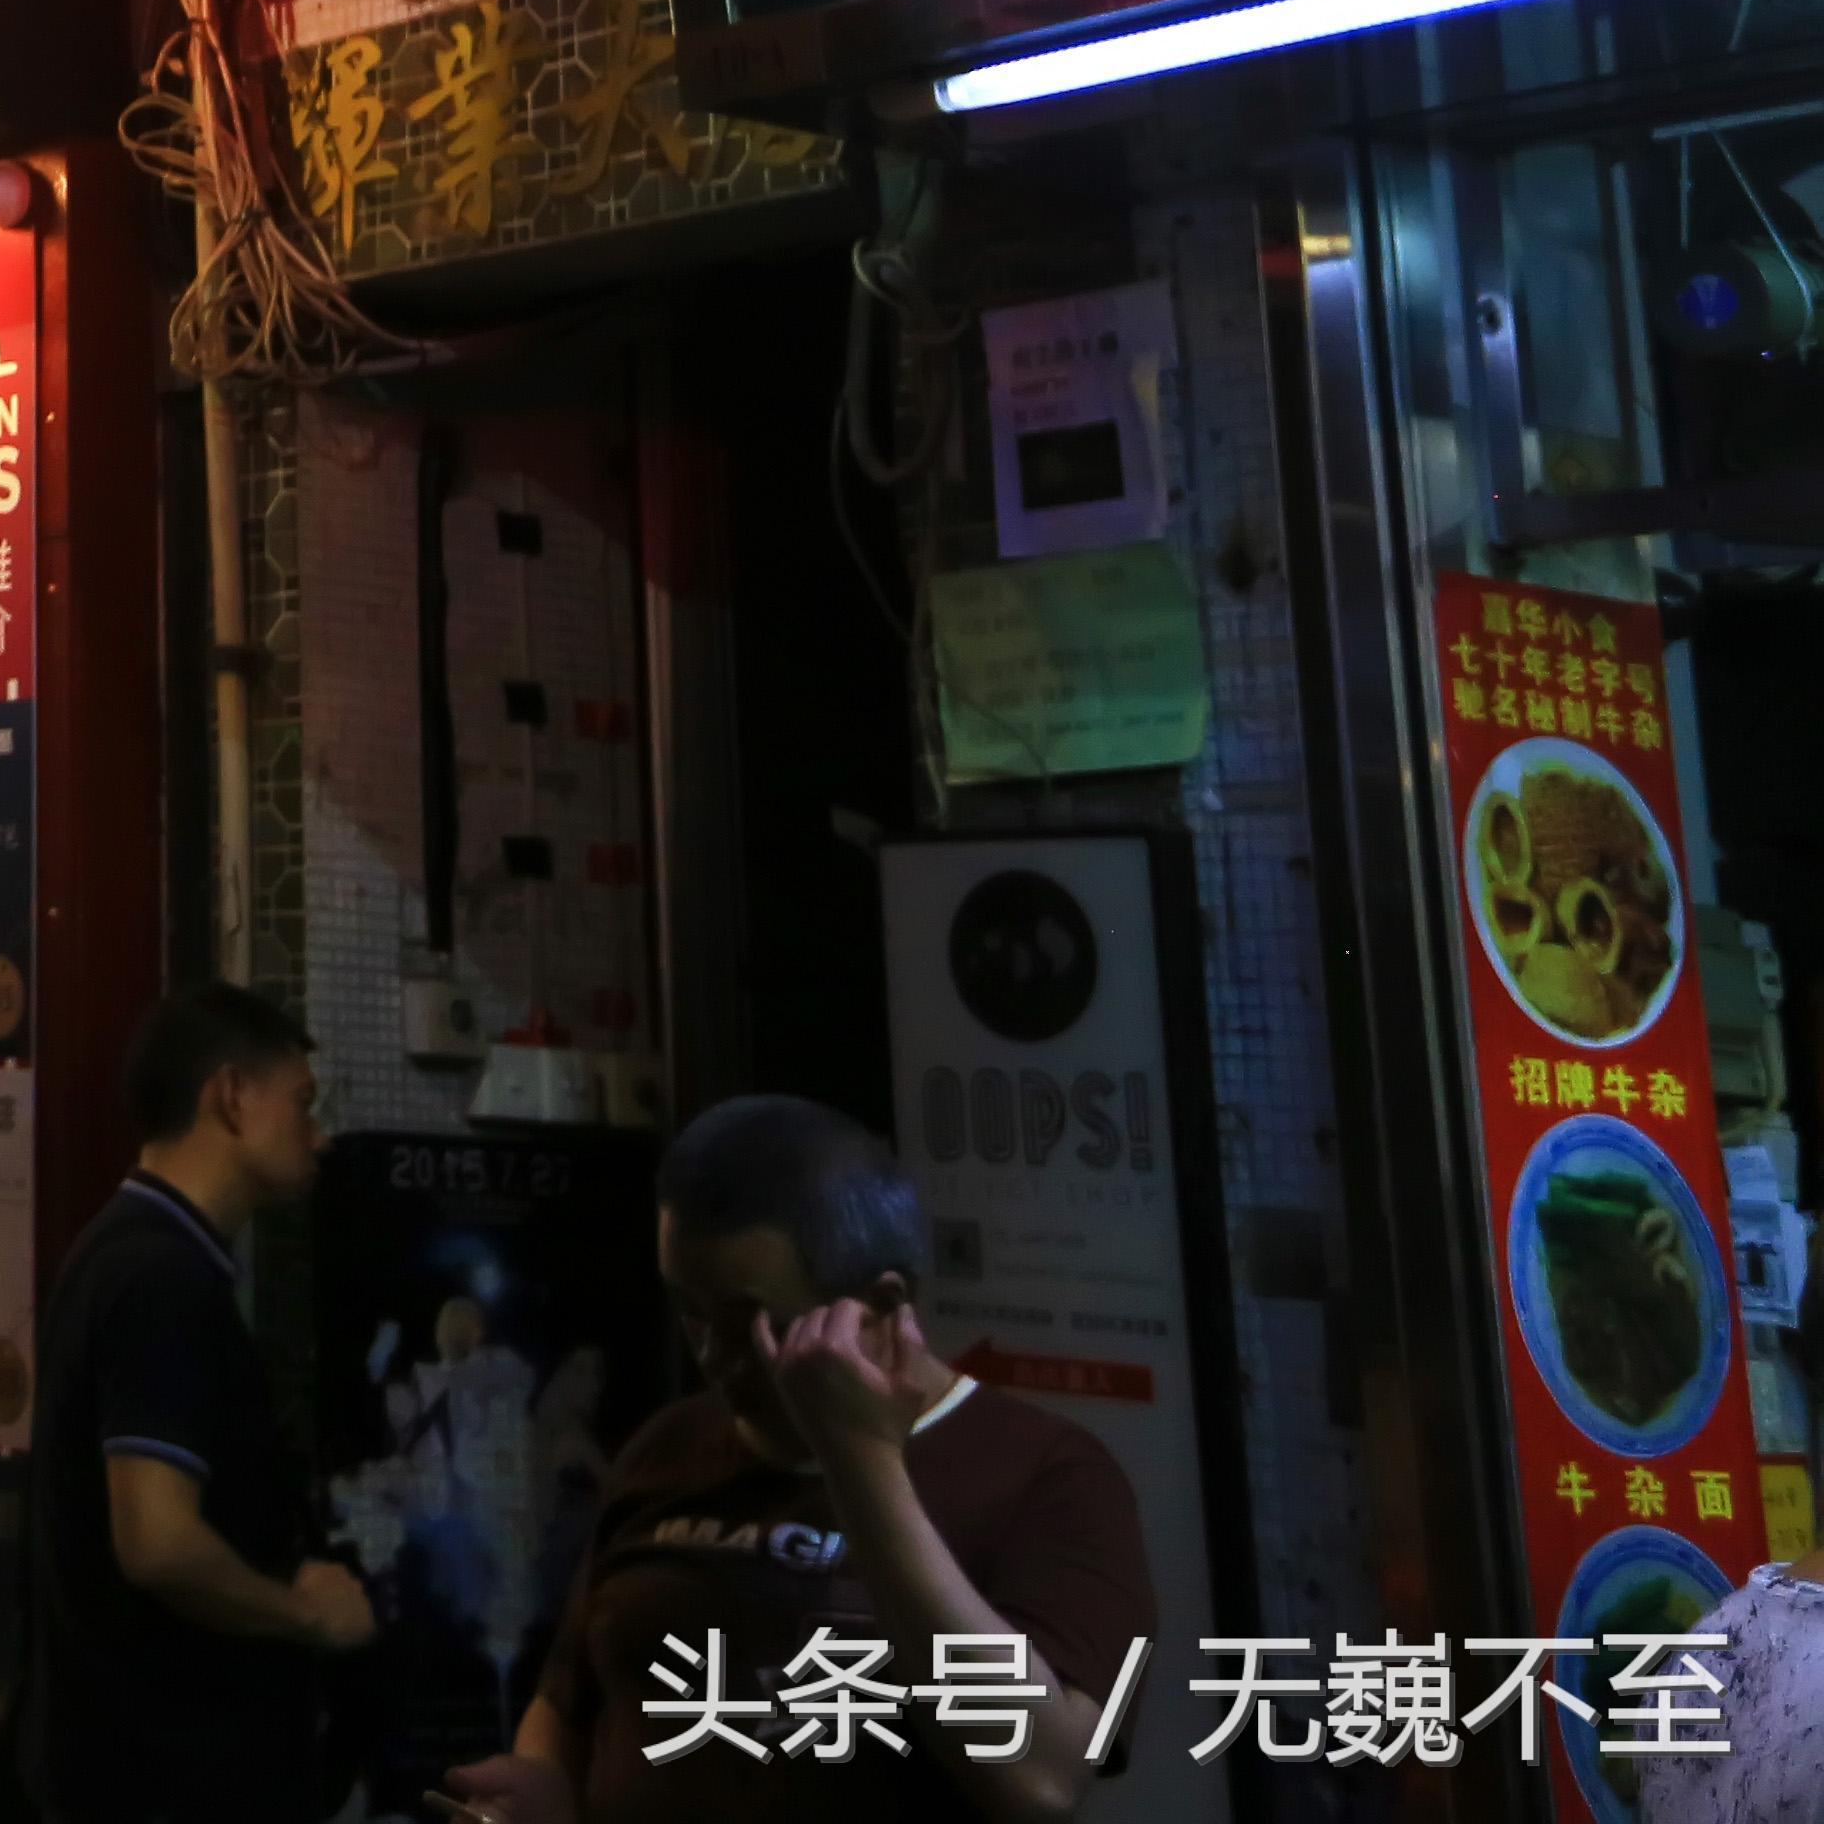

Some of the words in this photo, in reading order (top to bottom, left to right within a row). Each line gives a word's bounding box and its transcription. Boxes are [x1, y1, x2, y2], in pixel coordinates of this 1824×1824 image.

[1509, 1055, 1688, 1118] 招牌牛杂
[922, 1066, 1154, 1173] OOPS!
[1556, 1462, 1736, 1520] 牛杂面
